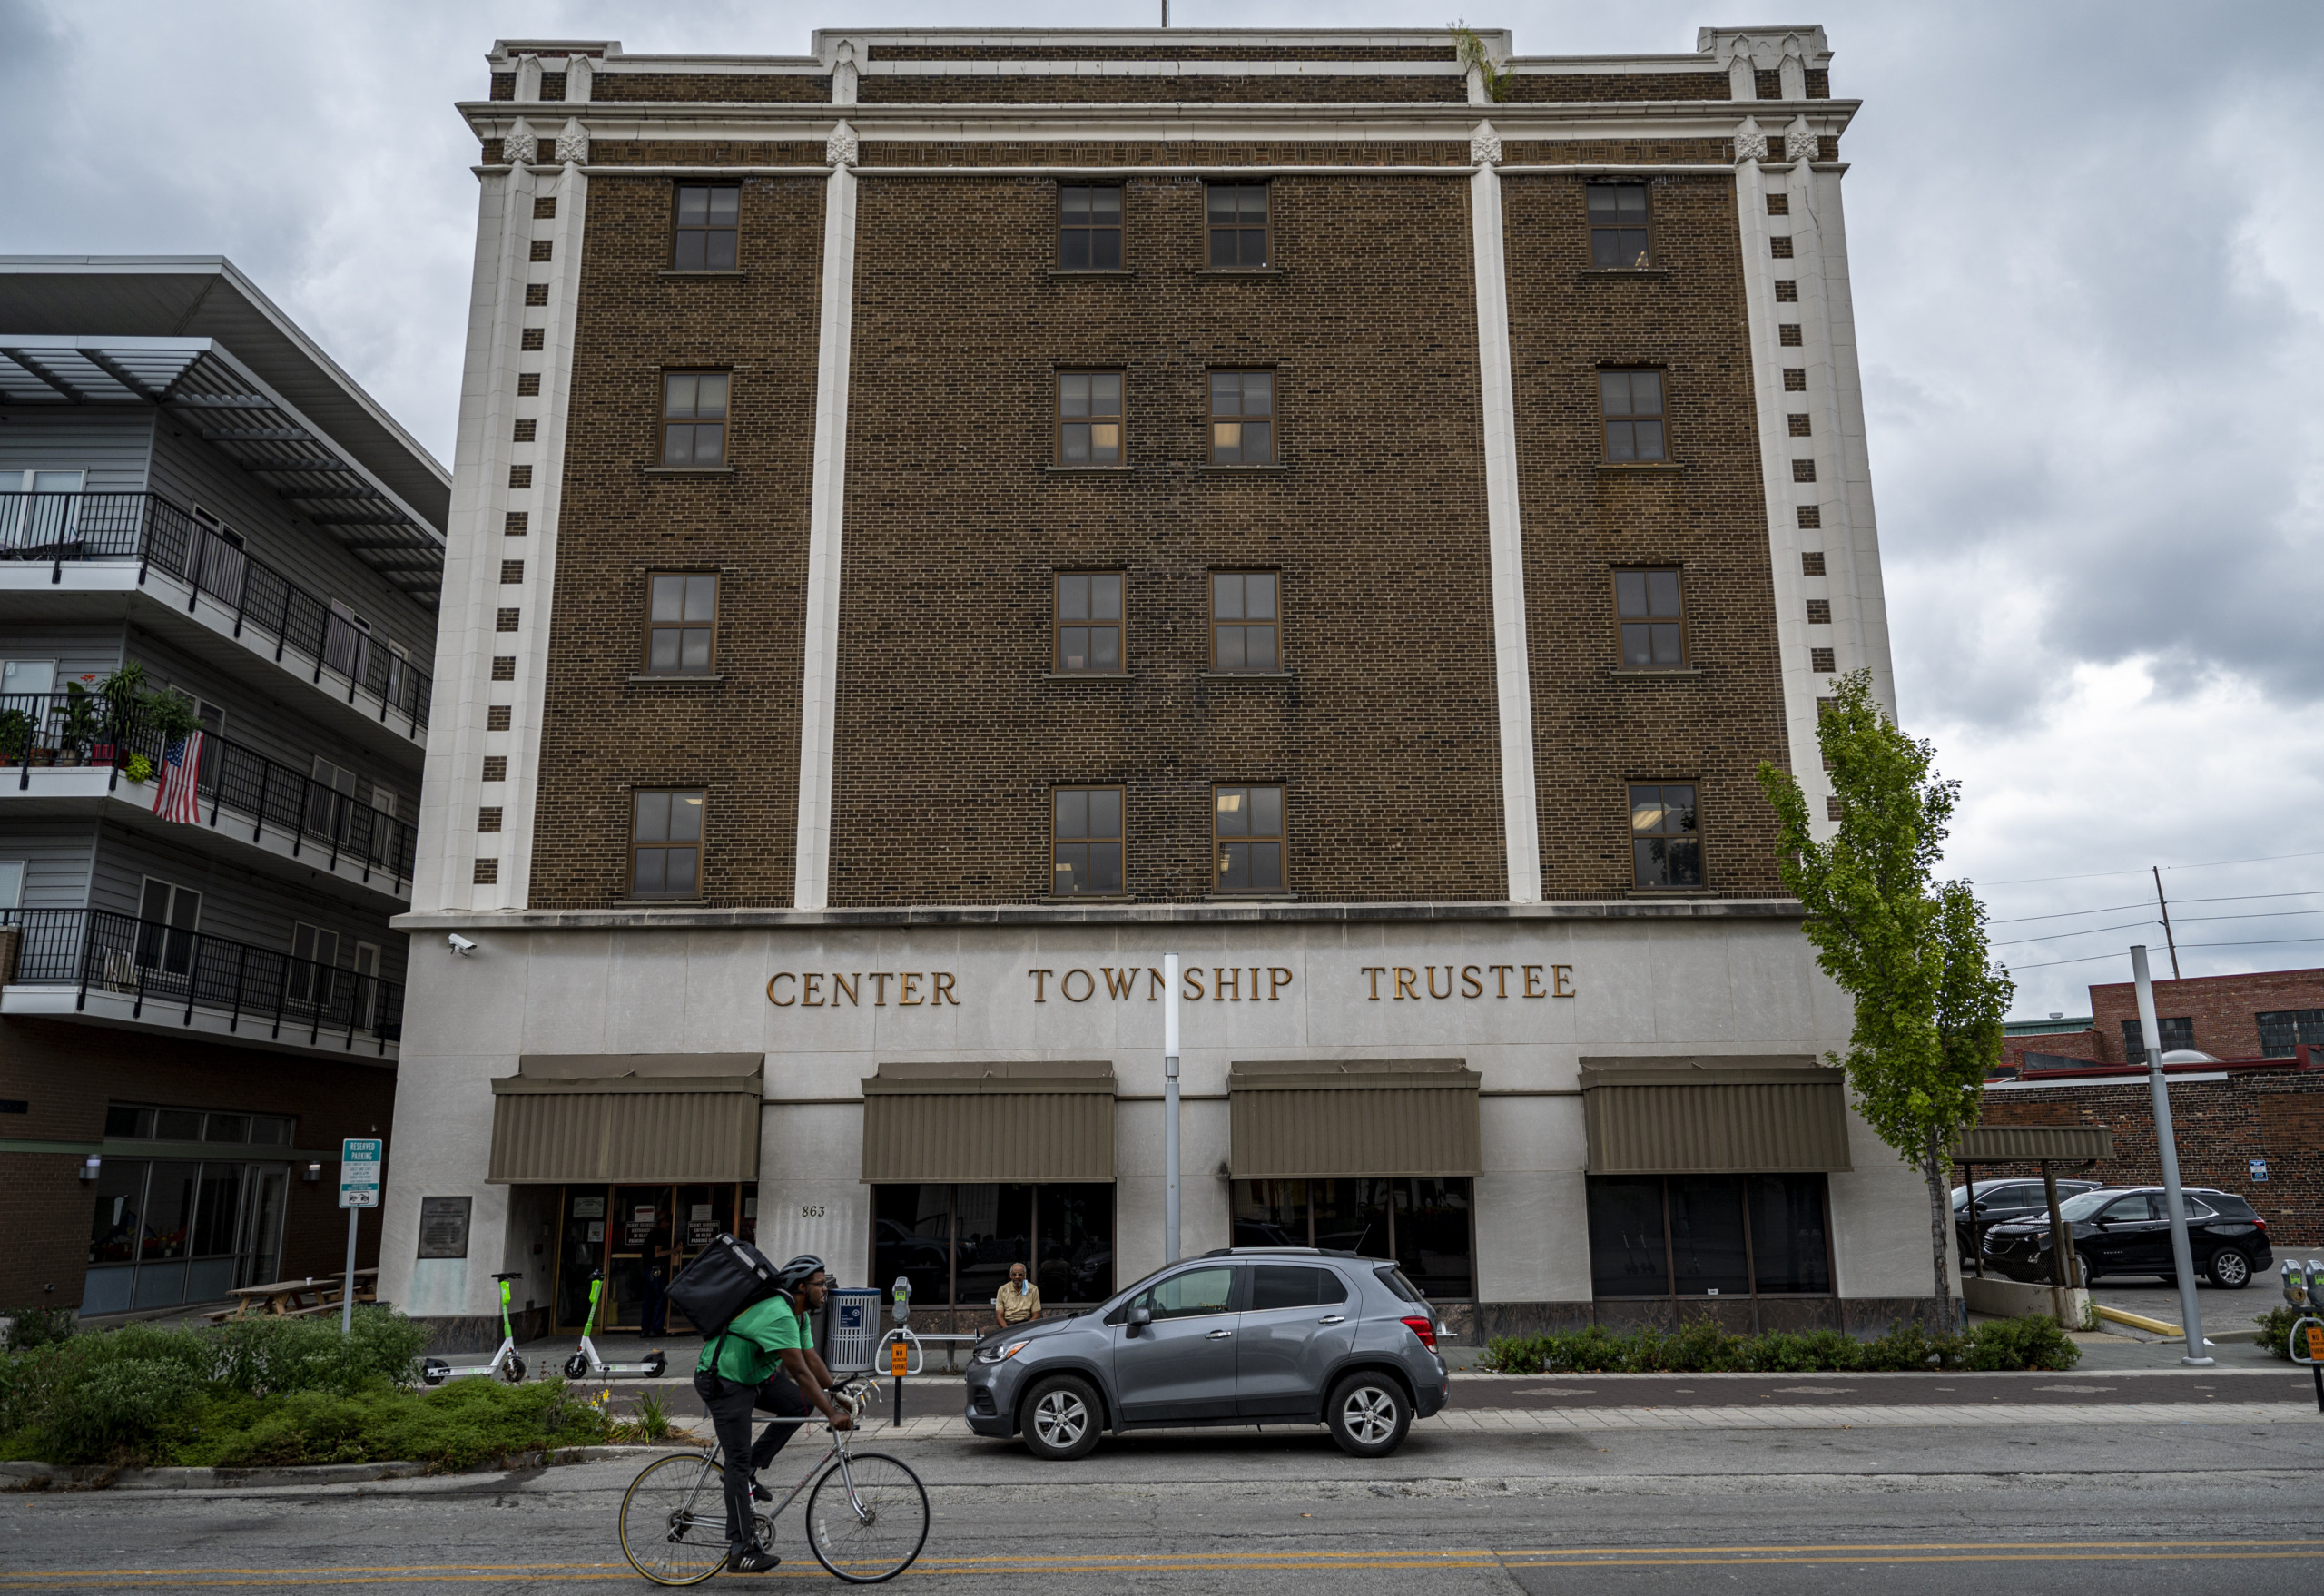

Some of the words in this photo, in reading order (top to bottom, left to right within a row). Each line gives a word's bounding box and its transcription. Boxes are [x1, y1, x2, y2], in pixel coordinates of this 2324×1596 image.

[766, 971, 960, 1007] CENTER
[1029, 967, 1293, 1002] TOWNSHIP
[1361, 964, 1576, 1000] TRUSTEE
[350, 1142, 375, 1151] RESERVED
[351, 1152, 373, 1160] PARKING
[802, 1206, 825, 1217] 863
